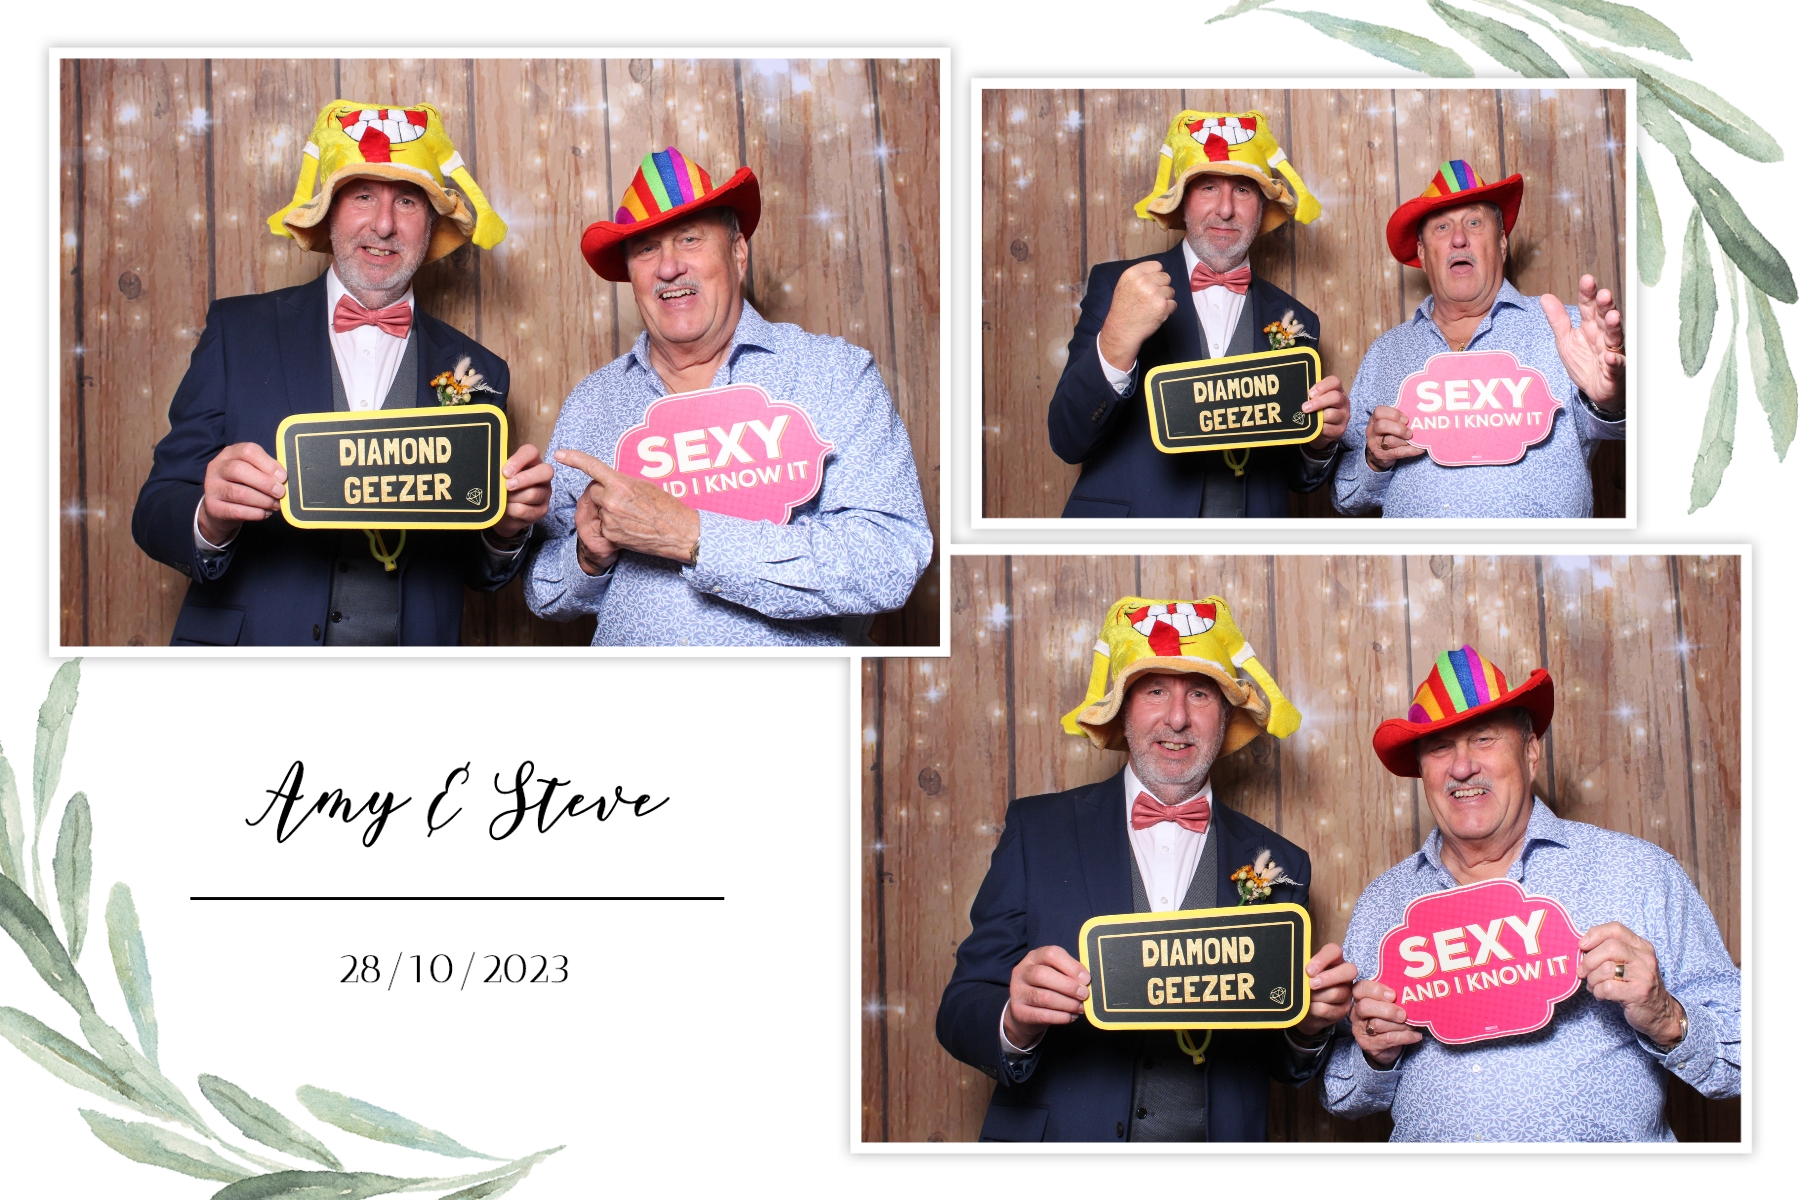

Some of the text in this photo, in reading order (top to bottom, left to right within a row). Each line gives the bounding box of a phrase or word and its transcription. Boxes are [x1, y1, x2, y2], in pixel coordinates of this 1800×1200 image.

[1192, 374, 1280, 404] DIAMOND
[1416, 376, 1534, 413] SEXY
[1199, 402, 1283, 433] GEEZER
[1409, 411, 1543, 430] AND I KNOW IT
[338, 436, 452, 467] DIAMOND
[637, 415, 789, 478] SEXY
[343, 472, 453, 505] GEEZER
[692, 477, 700, 495] I
[704, 465, 782, 494] KNOW
[787, 460, 808, 482] IT
[1141, 936, 1255, 968] DIAMOND
[1399, 908, 1546, 979] SEXY
[1146, 972, 1256, 1006] GEEZER
[1401, 955, 1569, 1005] AND I KNOW IT
